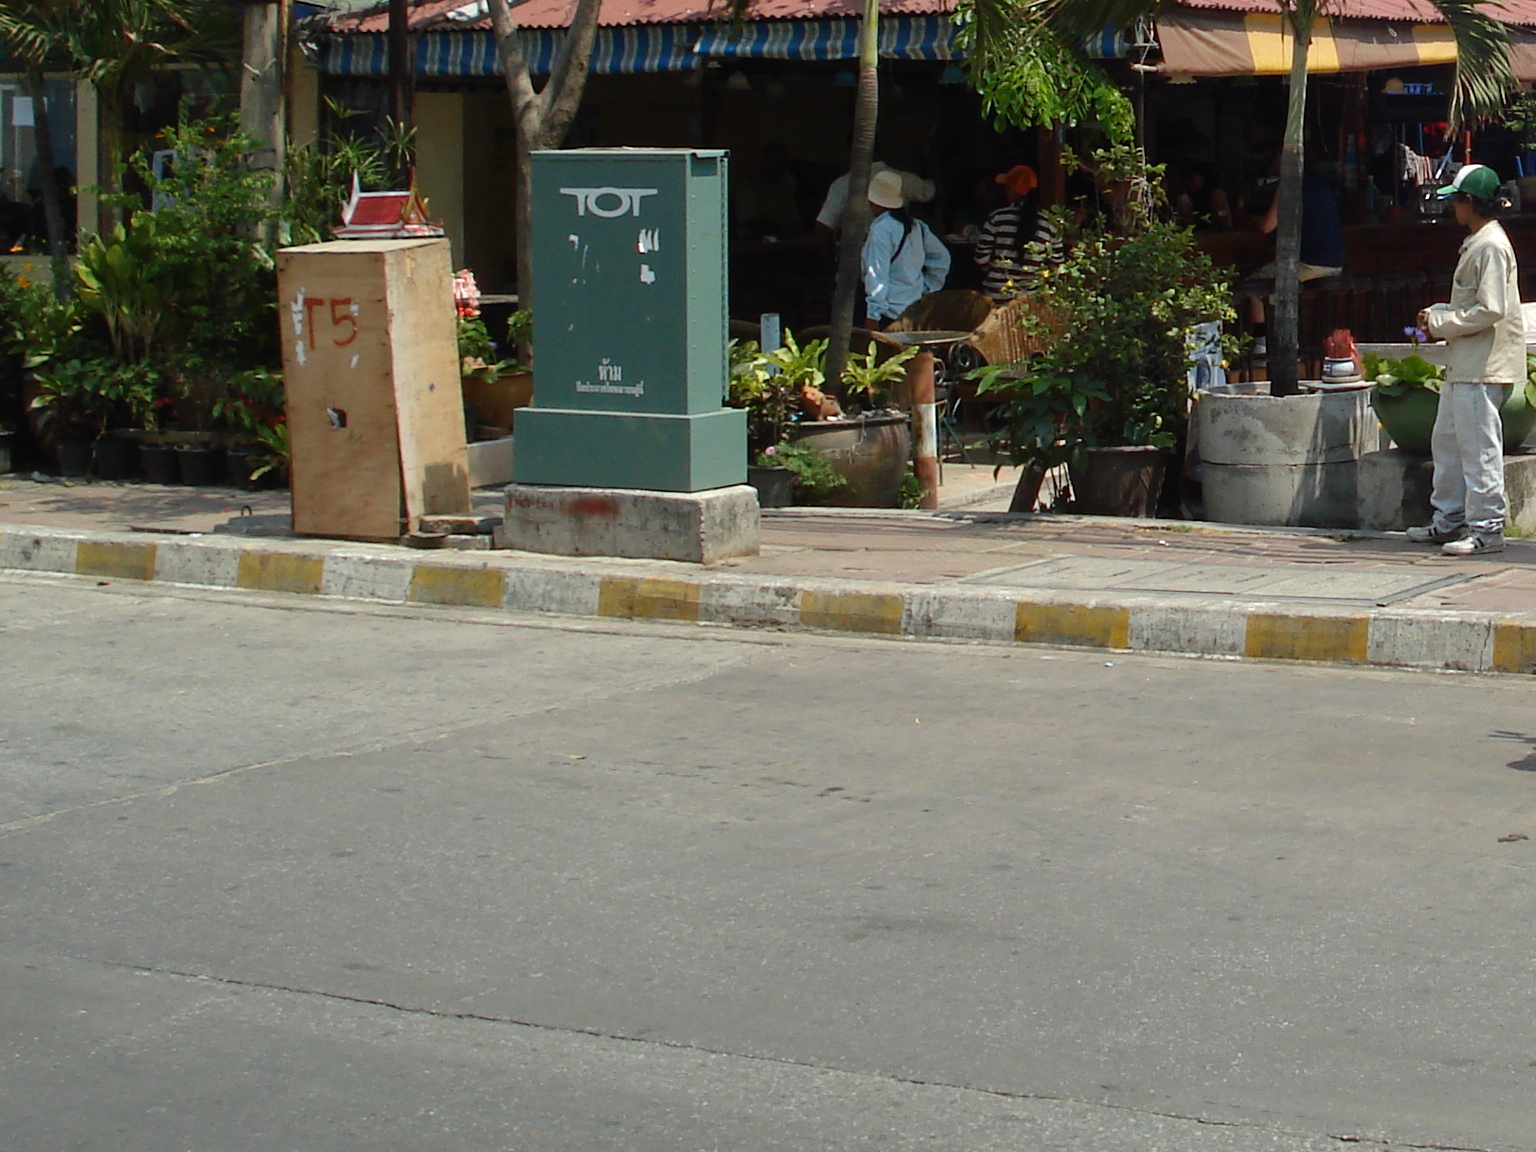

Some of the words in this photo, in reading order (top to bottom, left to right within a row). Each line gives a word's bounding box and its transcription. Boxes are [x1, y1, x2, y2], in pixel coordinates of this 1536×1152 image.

[559, 186, 659, 218] TOT
[303, 297, 358, 350] T5
[598, 357, 623, 381] ห้าม
